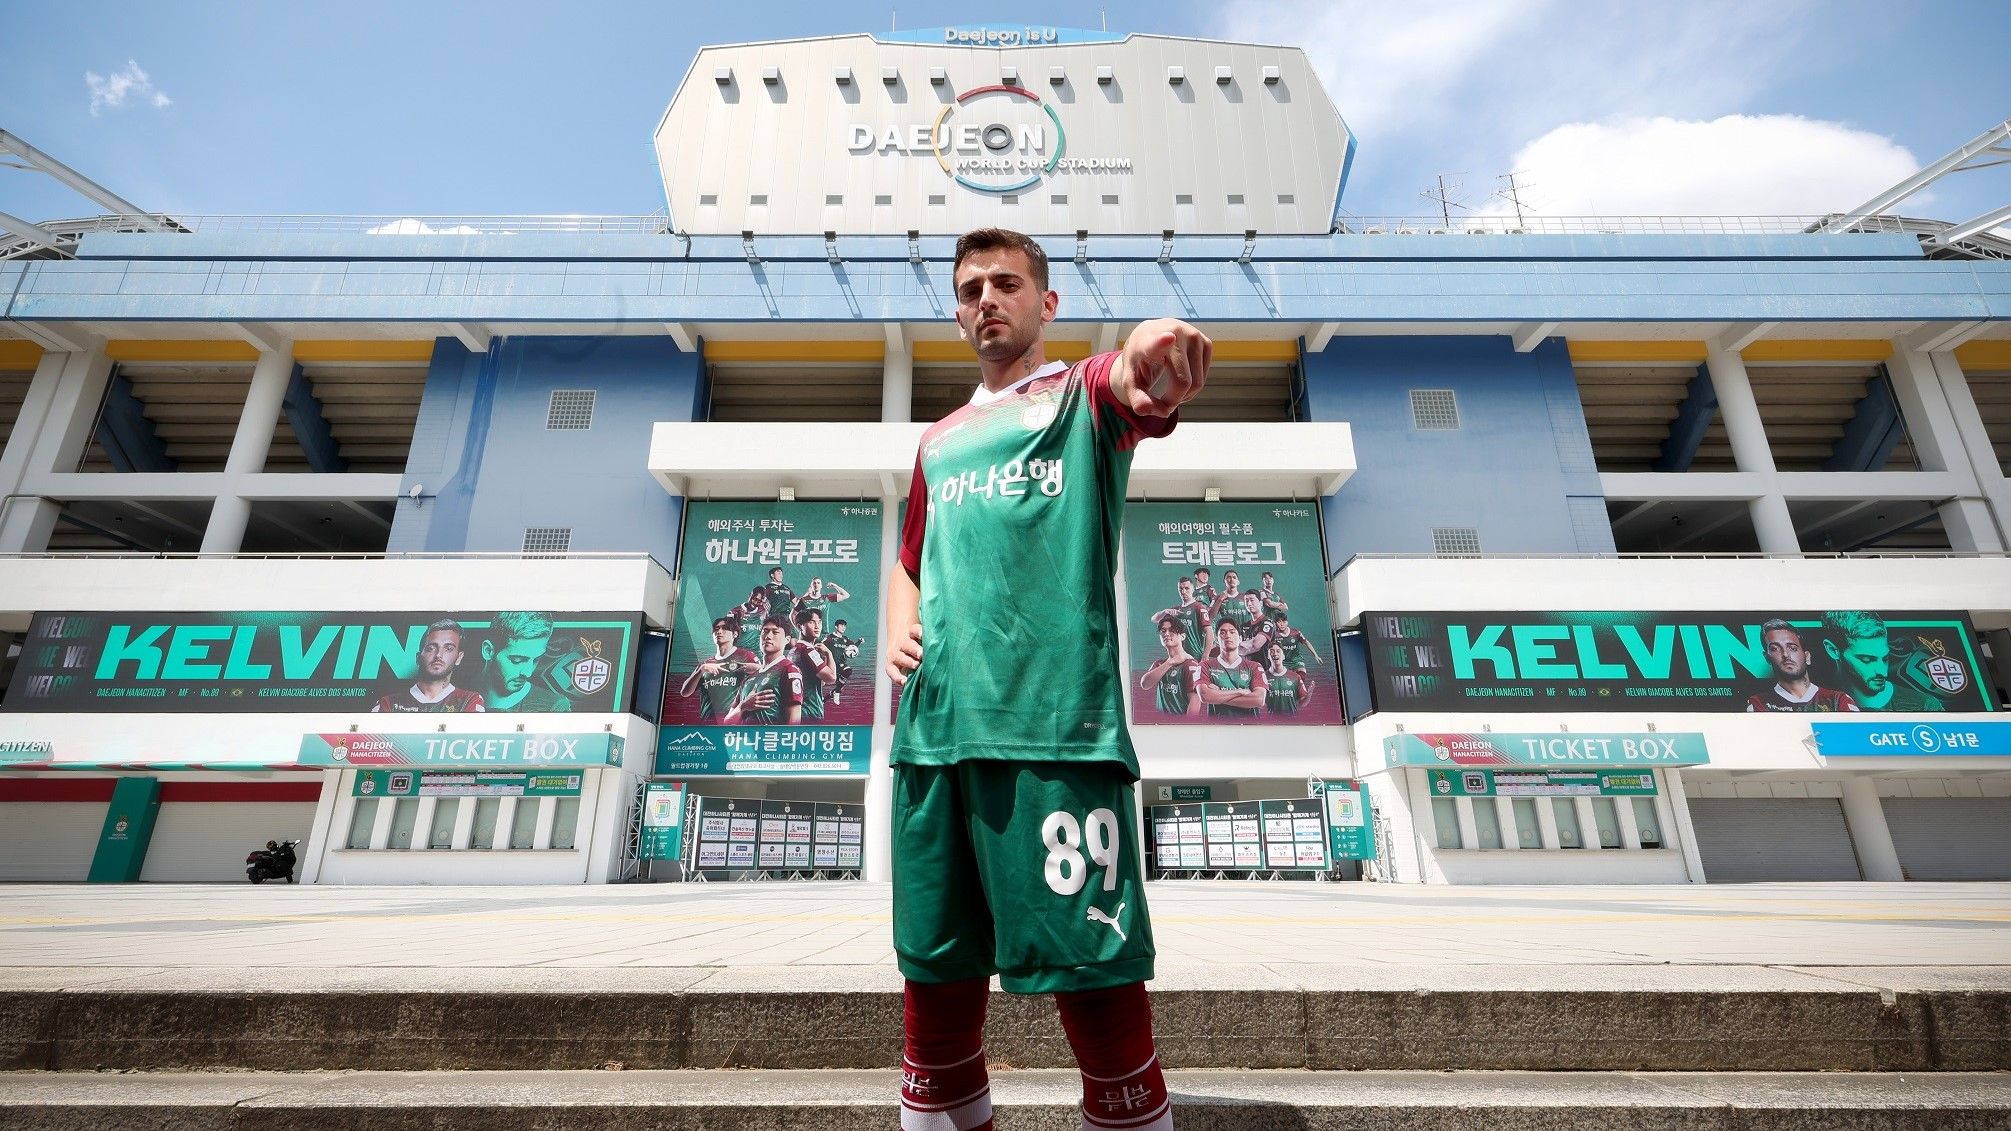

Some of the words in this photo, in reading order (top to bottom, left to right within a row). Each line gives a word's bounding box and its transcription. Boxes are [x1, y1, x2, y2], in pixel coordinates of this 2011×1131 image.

[945, 27, 1020, 45] Daejeon
[1025, 27, 1040, 42] is
[1043, 27, 1057, 42] U
[848, 123, 1043, 151] DAEJEON
[955, 158, 1011, 169] WORLD
[1017, 158, 1049, 169] CUP
[1057, 157, 1131, 168] STADIUM
[941, 458, 1063, 507] 하나은행
[851, 507, 878, 516] 하나증권
[1282, 509, 1310, 517] 하나카드
[708, 519, 755, 532] 해외주식
[759, 519, 795, 532] 투자는
[1158, 522, 1215, 535] 해외여행의
[1219, 522, 1253, 536] 필수품
[705, 538, 860, 565] 하나원큐프로
[1161, 540, 1286, 566] 트래블로그
[94, 625, 428, 680] KELVIN
[1447, 625, 1772, 680] KELVIN
[96, 687, 125, 697] DAEJEON
[126, 687, 167, 697] HANACITIZEN
[178, 688, 189, 697] MF
[200, 687, 220, 697] No.89
[258, 687, 280, 697] KELVIN
[308, 687, 327, 697] ALVES
[328, 687, 341, 697] DOS
[341, 687, 367, 697] SANTOS
[1465, 687, 1494, 697] DAEJEON
[1494, 687, 1534, 697] HANACITIZEN
[1546, 687, 1556, 697] MF
[1568, 687, 1587, 697] No.89
[1625, 687, 1647, 697] KELVIN
[1675, 687, 1694, 697] ALVES
[1694, 687, 1707, 697] DOS
[1708, 687, 1732, 697] SANTOS
[352, 741, 393, 750] DAEJEON
[724, 731, 854, 751] 하나클라이밍짐
[1451, 741, 1492, 750] DAEJEON
[1869, 733, 1909, 746] GATE
[1919, 731, 1934, 748] S
[1942, 732, 1980, 748] 남1문
[425, 739, 515, 760] TICKET
[522, 739, 579, 760] BOX
[1522, 739, 1612, 760] TICKET
[1622, 739, 1679, 760] BOX
[1041, 807, 1121, 896] 89
